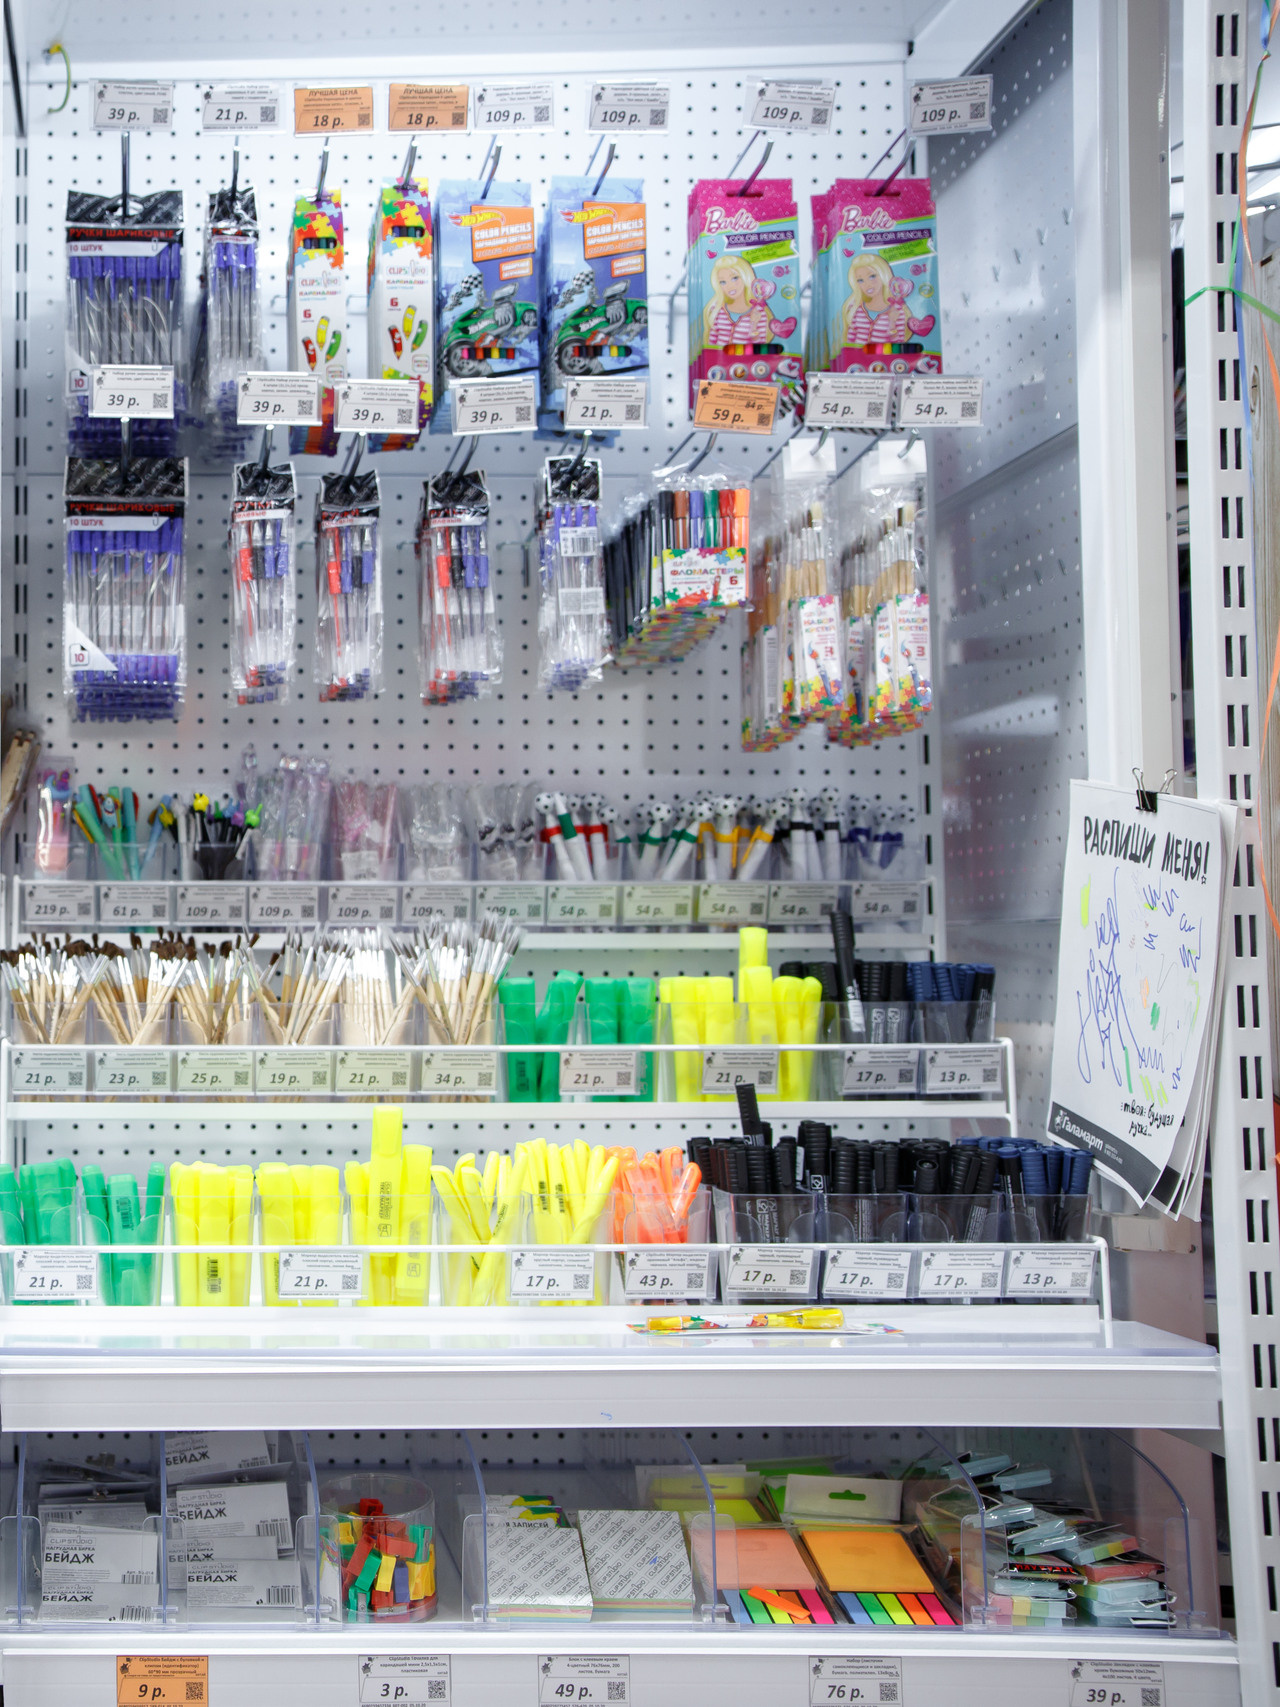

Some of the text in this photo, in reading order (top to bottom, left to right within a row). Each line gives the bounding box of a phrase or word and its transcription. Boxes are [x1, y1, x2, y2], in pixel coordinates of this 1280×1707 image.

[309, 89, 338, 97] ЛУЧШАЯ
[403, 87, 433, 95] ЛУЧШАЯ
[108, 108, 139, 123] 39 р.
[313, 115, 344, 129] 18 р.
[407, 113, 438, 127] 18 р.
[601, 111, 640, 125] 109 р.
[921, 109, 961, 123] 109 р.
[704, 206, 760, 235] Barbie
[841, 205, 897, 234] Barbie
[70, 228, 175, 238] РУЧКИ ШАРИКОВЫЕ
[474, 222, 532, 239] COLOR PENCILS
[586, 219, 644, 238] COLOR PENCILS
[729, 231, 794, 244] COLOR PENCILS
[866, 230, 930, 243] COLOR PENCILS
[80, 244, 103, 252] ШТУК
[108, 394, 139, 408] 39 р.
[822, 403, 854, 417] 54 р.
[70, 502, 175, 513] РУЧКИ ШАРИКОВЫЕ
[70, 518, 104, 526] 10 ШТУК
[670, 568, 744, 576] ФЛОМАСТЕРЫ
[729, 576, 738, 585] 6
[73, 652, 85, 663] 10
[1084, 815, 1210, 884] РАСПИШИ МЕНЯ!
[35, 904, 69, 916] 219 р.
[25, 1073, 56, 1086] 21 р.
[435, 1073, 465, 1086] 34 р.
[1061, 1115, 1104, 1151] Галамарт
[640, 1275, 673, 1289] 43 р.
[1023, 1273, 1056, 1287] 13 р.
[165, 1450, 210, 1466] БЕЙДЖ
[179, 1507, 227, 1521] БЕЙДЖ
[512, 1521, 549, 1529] ЗАПИСЕЙ
[589, 1511, 614, 1534] CLIPSTUDIO
[45, 1551, 94, 1564] БЕЙДЖ
[637, 1543, 661, 1568] CLIPSTUDIO
[188, 1573, 237, 1583] БЕЙДЖ
[42, 1594, 93, 1602] БЕЙДЖ
[138, 1684, 165, 1701] 9 р.
[555, 1684, 592, 1700] 49 р.
[1087, 1689, 1125, 1706] 39 р.
